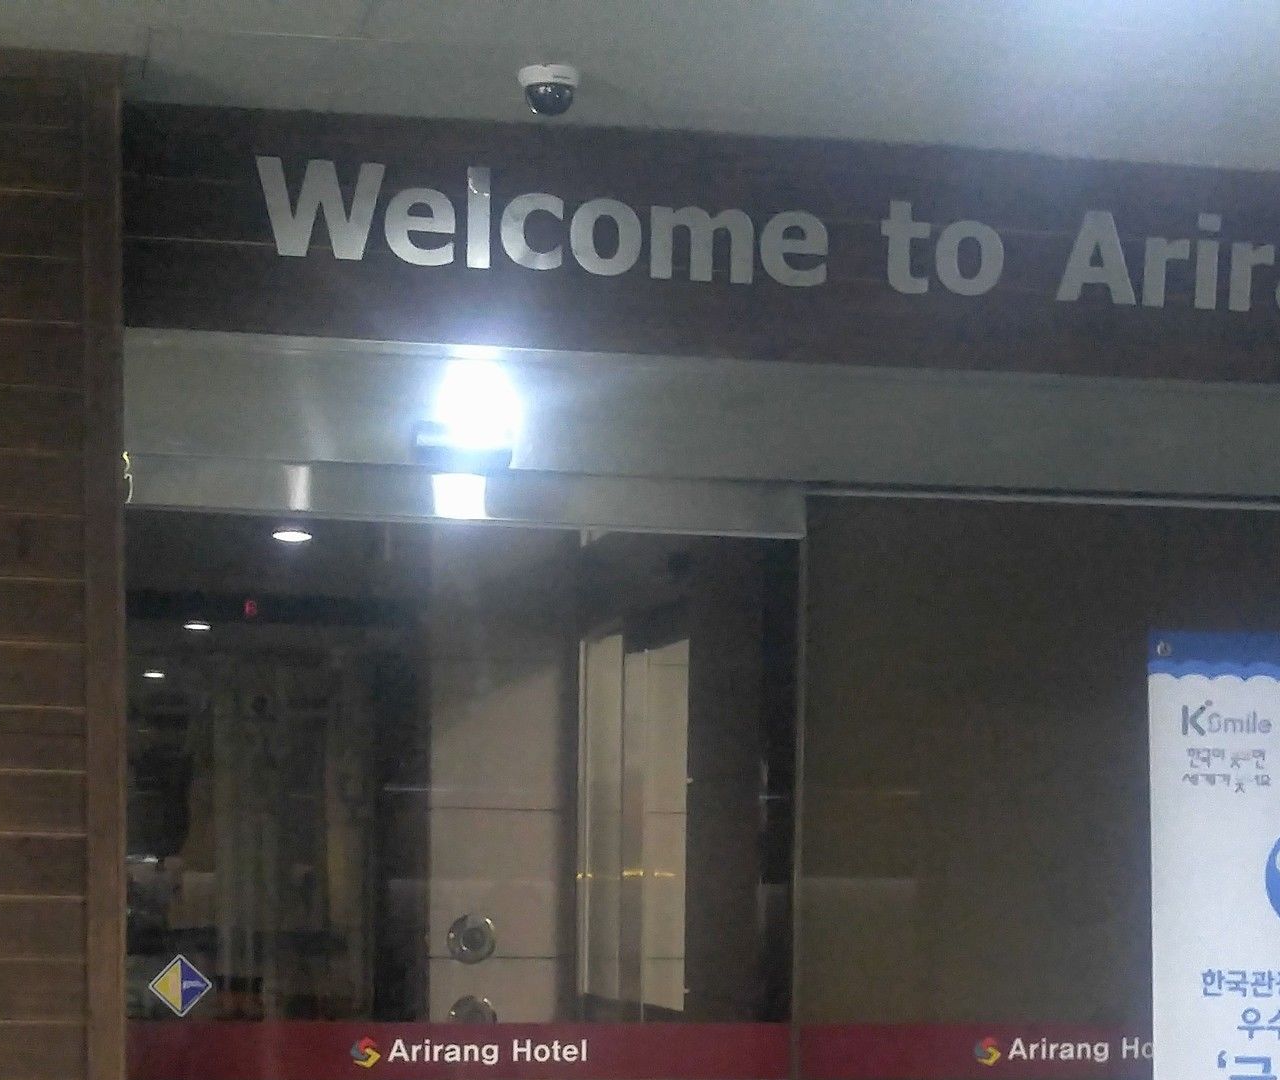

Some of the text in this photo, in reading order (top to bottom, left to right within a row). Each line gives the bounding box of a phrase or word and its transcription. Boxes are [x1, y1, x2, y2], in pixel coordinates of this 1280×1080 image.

[255, 155, 828, 288] Welcome
[880, 200, 1005, 297] to
[387, 1038, 588, 1065] Arirang Hotel
[1007, 1036, 1153, 1063] Arirang Ho
